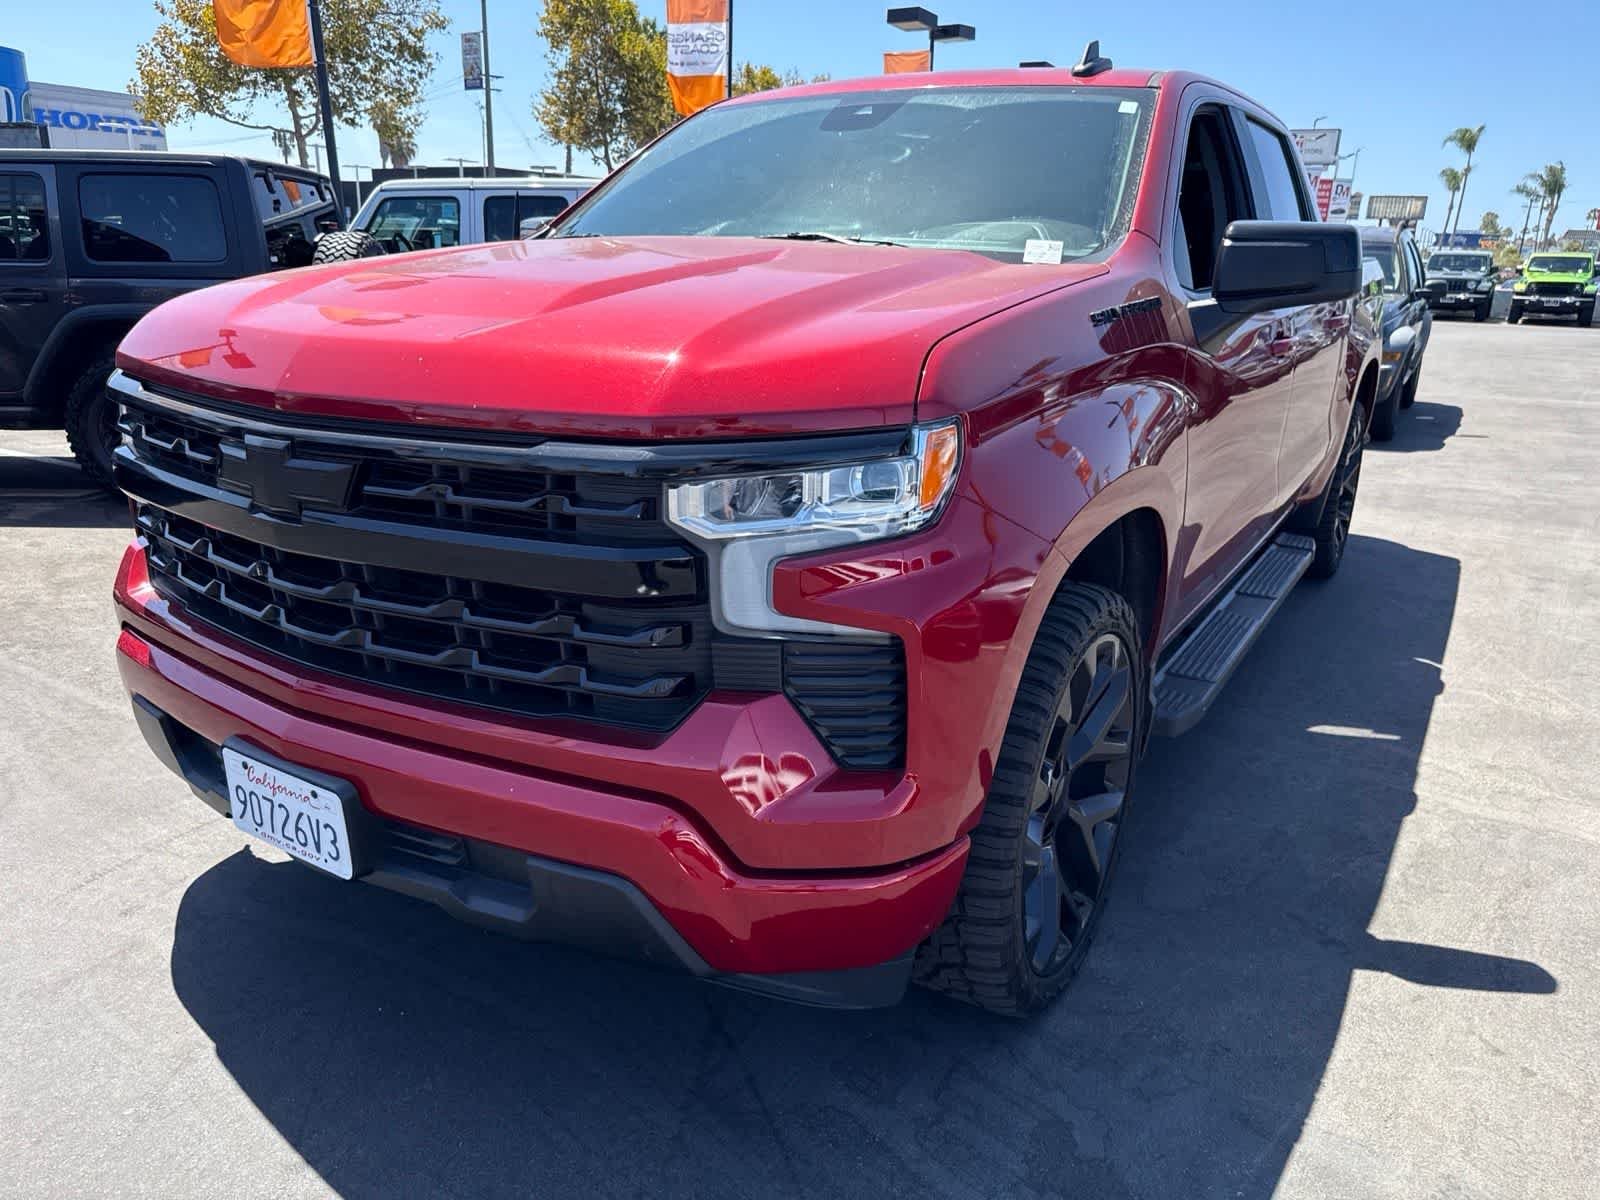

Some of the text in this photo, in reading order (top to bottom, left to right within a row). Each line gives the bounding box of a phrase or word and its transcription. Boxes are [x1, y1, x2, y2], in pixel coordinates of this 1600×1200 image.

[33, 107, 165, 138] HONDA
[247, 765, 320, 810] California
[235, 784, 341, 861] 90726V3
